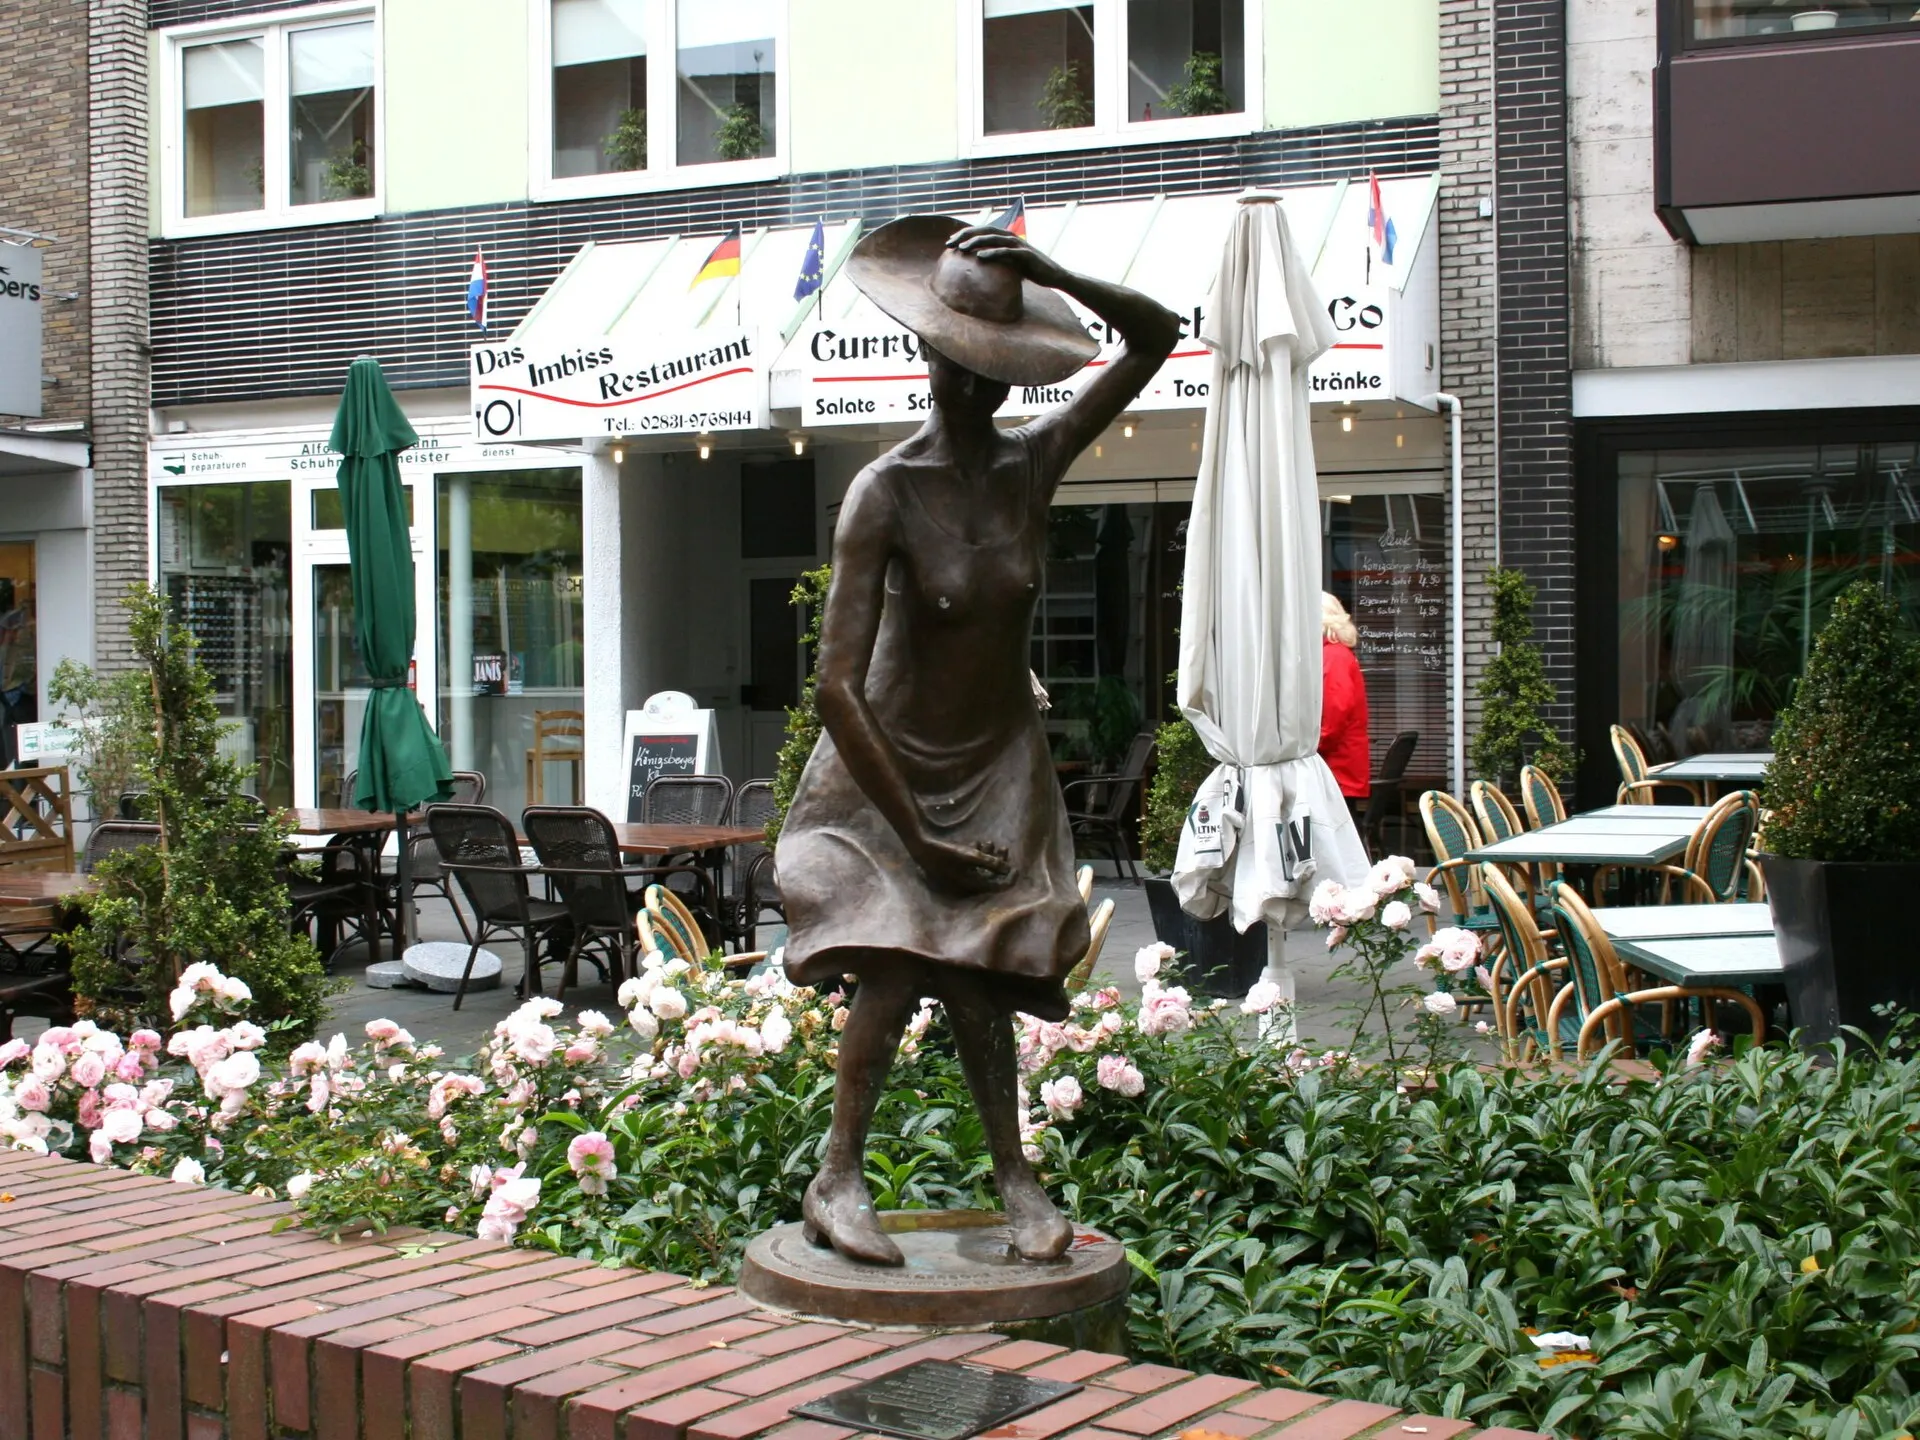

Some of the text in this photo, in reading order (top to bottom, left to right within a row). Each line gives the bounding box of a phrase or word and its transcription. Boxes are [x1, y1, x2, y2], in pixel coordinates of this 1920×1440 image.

[1327, 296, 1384, 331] Co
[475, 335, 753, 400] Das Imbiss Restaurant
[815, 396, 876, 416] Salate
[1308, 370, 1382, 391] tränke
[603, 410, 752, 433] Tel.: 02831-9768144
[191, 461, 247, 473] reparaturen
[482, 448, 515, 457] dienst
